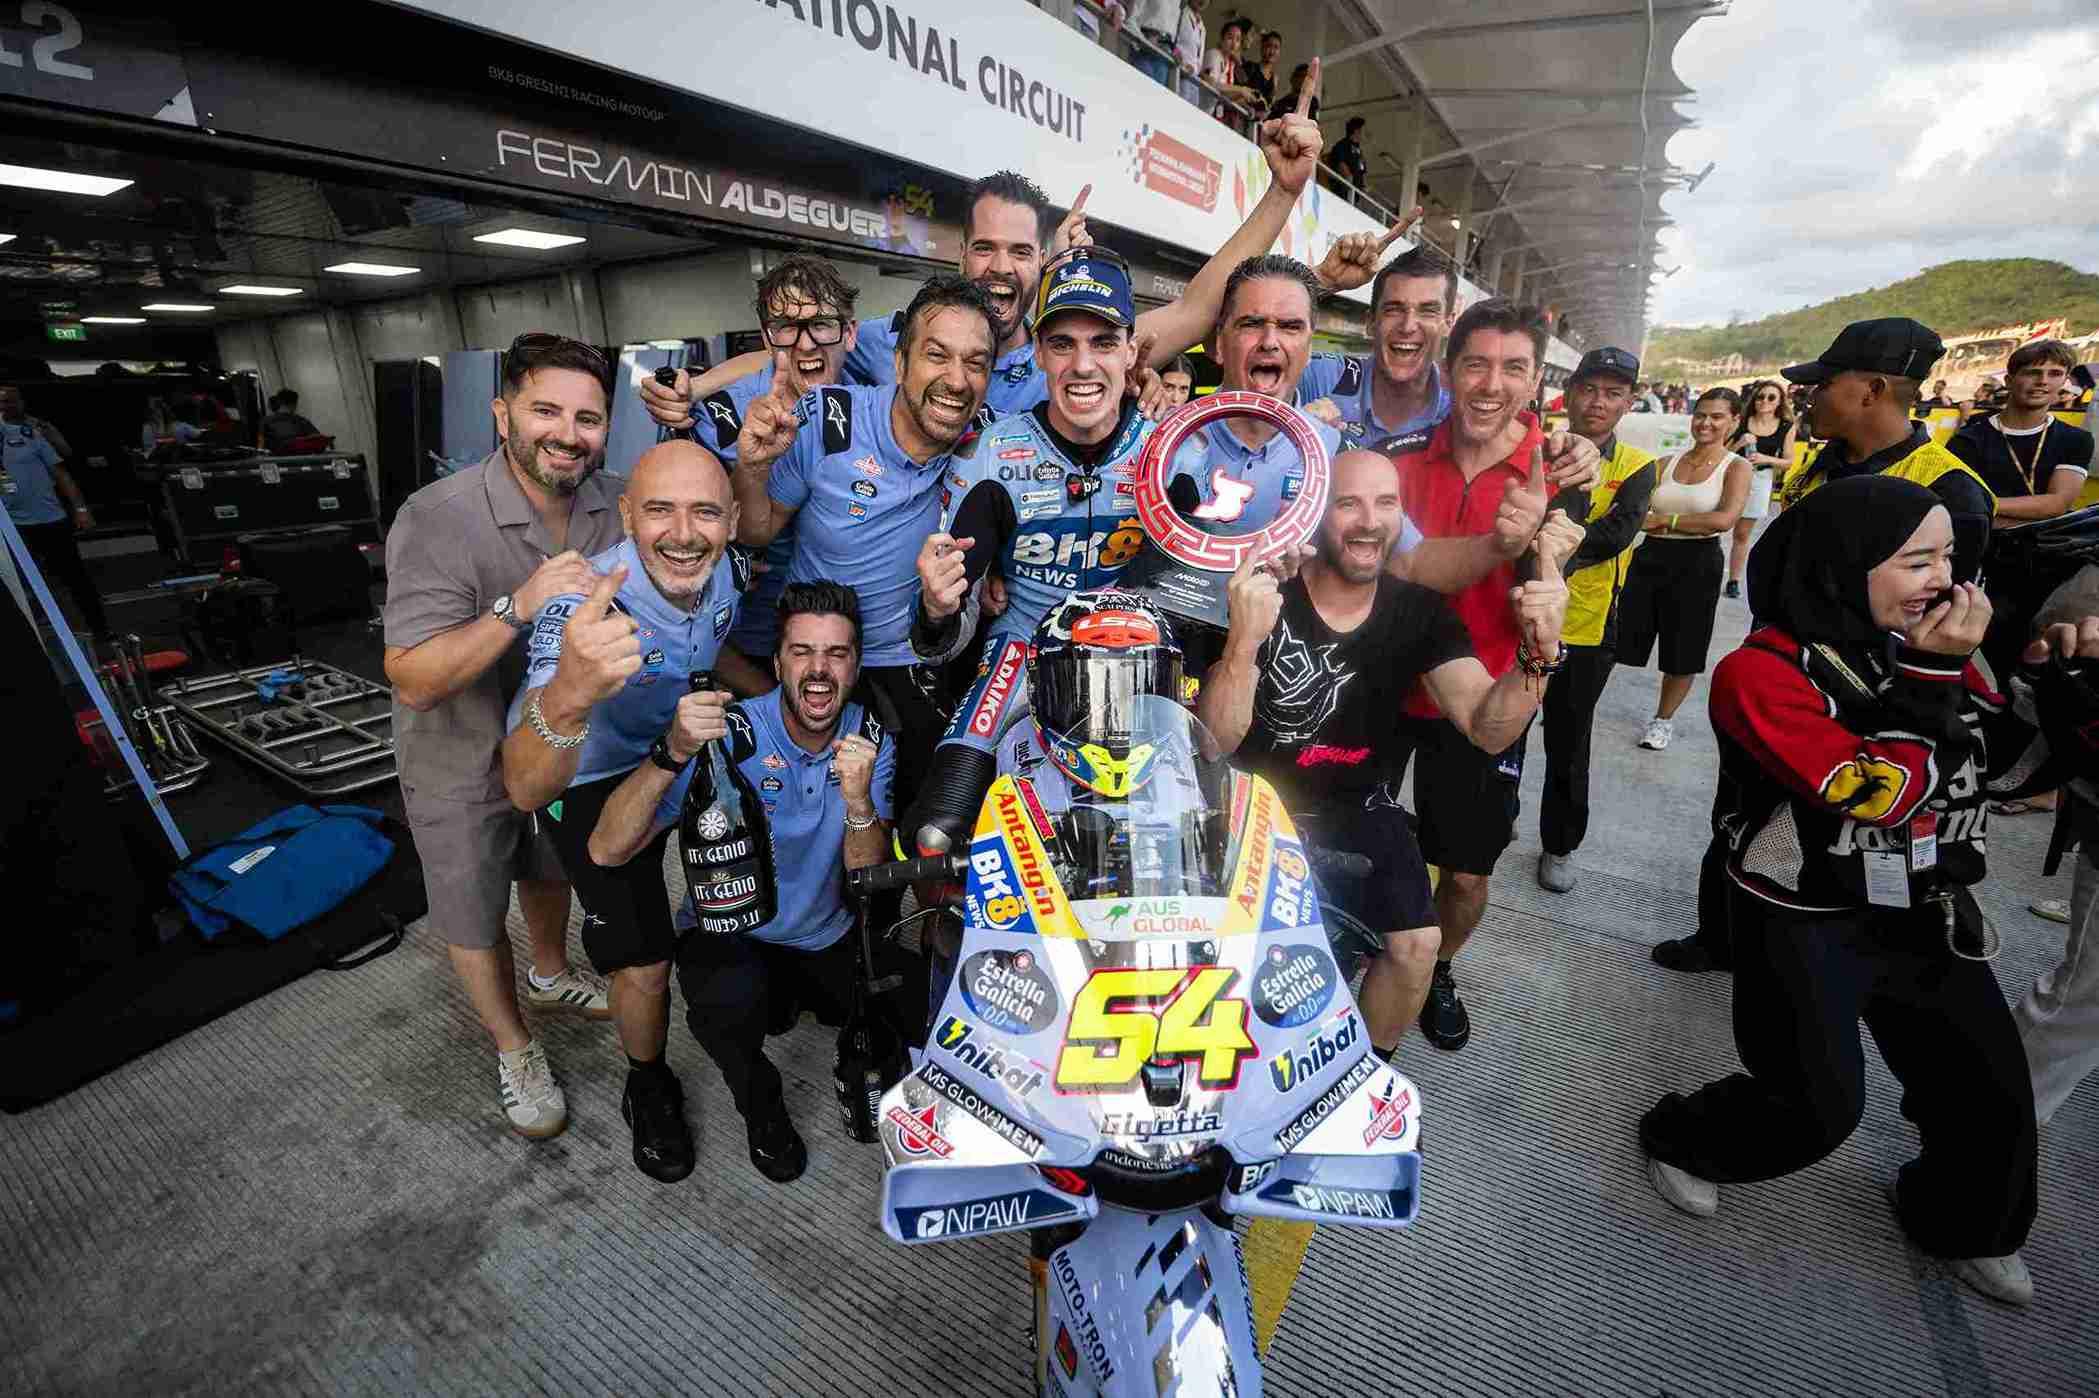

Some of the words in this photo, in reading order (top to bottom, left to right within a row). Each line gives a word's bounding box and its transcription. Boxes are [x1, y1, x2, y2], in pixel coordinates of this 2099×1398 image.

[516, 74, 569, 98] GRESINI
[572, 90, 617, 112] RACING
[978, 55, 1086, 142] CIRCUIT
[497, 129, 712, 204] FERMIN
[720, 181, 887, 238] ALDEGUER
[1048, 283, 1112, 303] MICHELIN
[54, 328, 76, 340] EXIT
[1015, 563, 1077, 589] NEWS
[706, 840, 746, 863] GENIO
[994, 792, 1056, 916] Antangin
[713, 876, 756, 899] GENIO
[970, 848, 1021, 924] BK8
[1271, 849, 1308, 928] BK8
[965, 894, 986, 928] NEWS
[1134, 917, 1216, 933] GLOBAL
[1138, 901, 1181, 916] AUS
[979, 956, 1045, 1006] Estrella
[1261, 954, 1317, 999] Estrella
[1272, 973, 1325, 1015] Galicia
[974, 975, 1034, 1022] Galicia
[1054, 968, 1258, 1088] 54
[936, 1015, 1044, 1097] Unibat
[1270, 1013, 1358, 1093] Unibat
[923, 1063, 949, 1090] MS
[889, 1107, 930, 1142] FEDERAL
[930, 1134, 950, 1155] OIL
[1279, 1121, 1304, 1150] MS
[1364, 1106, 1394, 1144] FEDERAL
[1394, 1091, 1410, 1112] OIL
[946, 1194, 1030, 1234] NPAW
[1318, 1187, 1395, 1218] NPAW
[1055, 1249, 1115, 1383] MOTO-TRON
